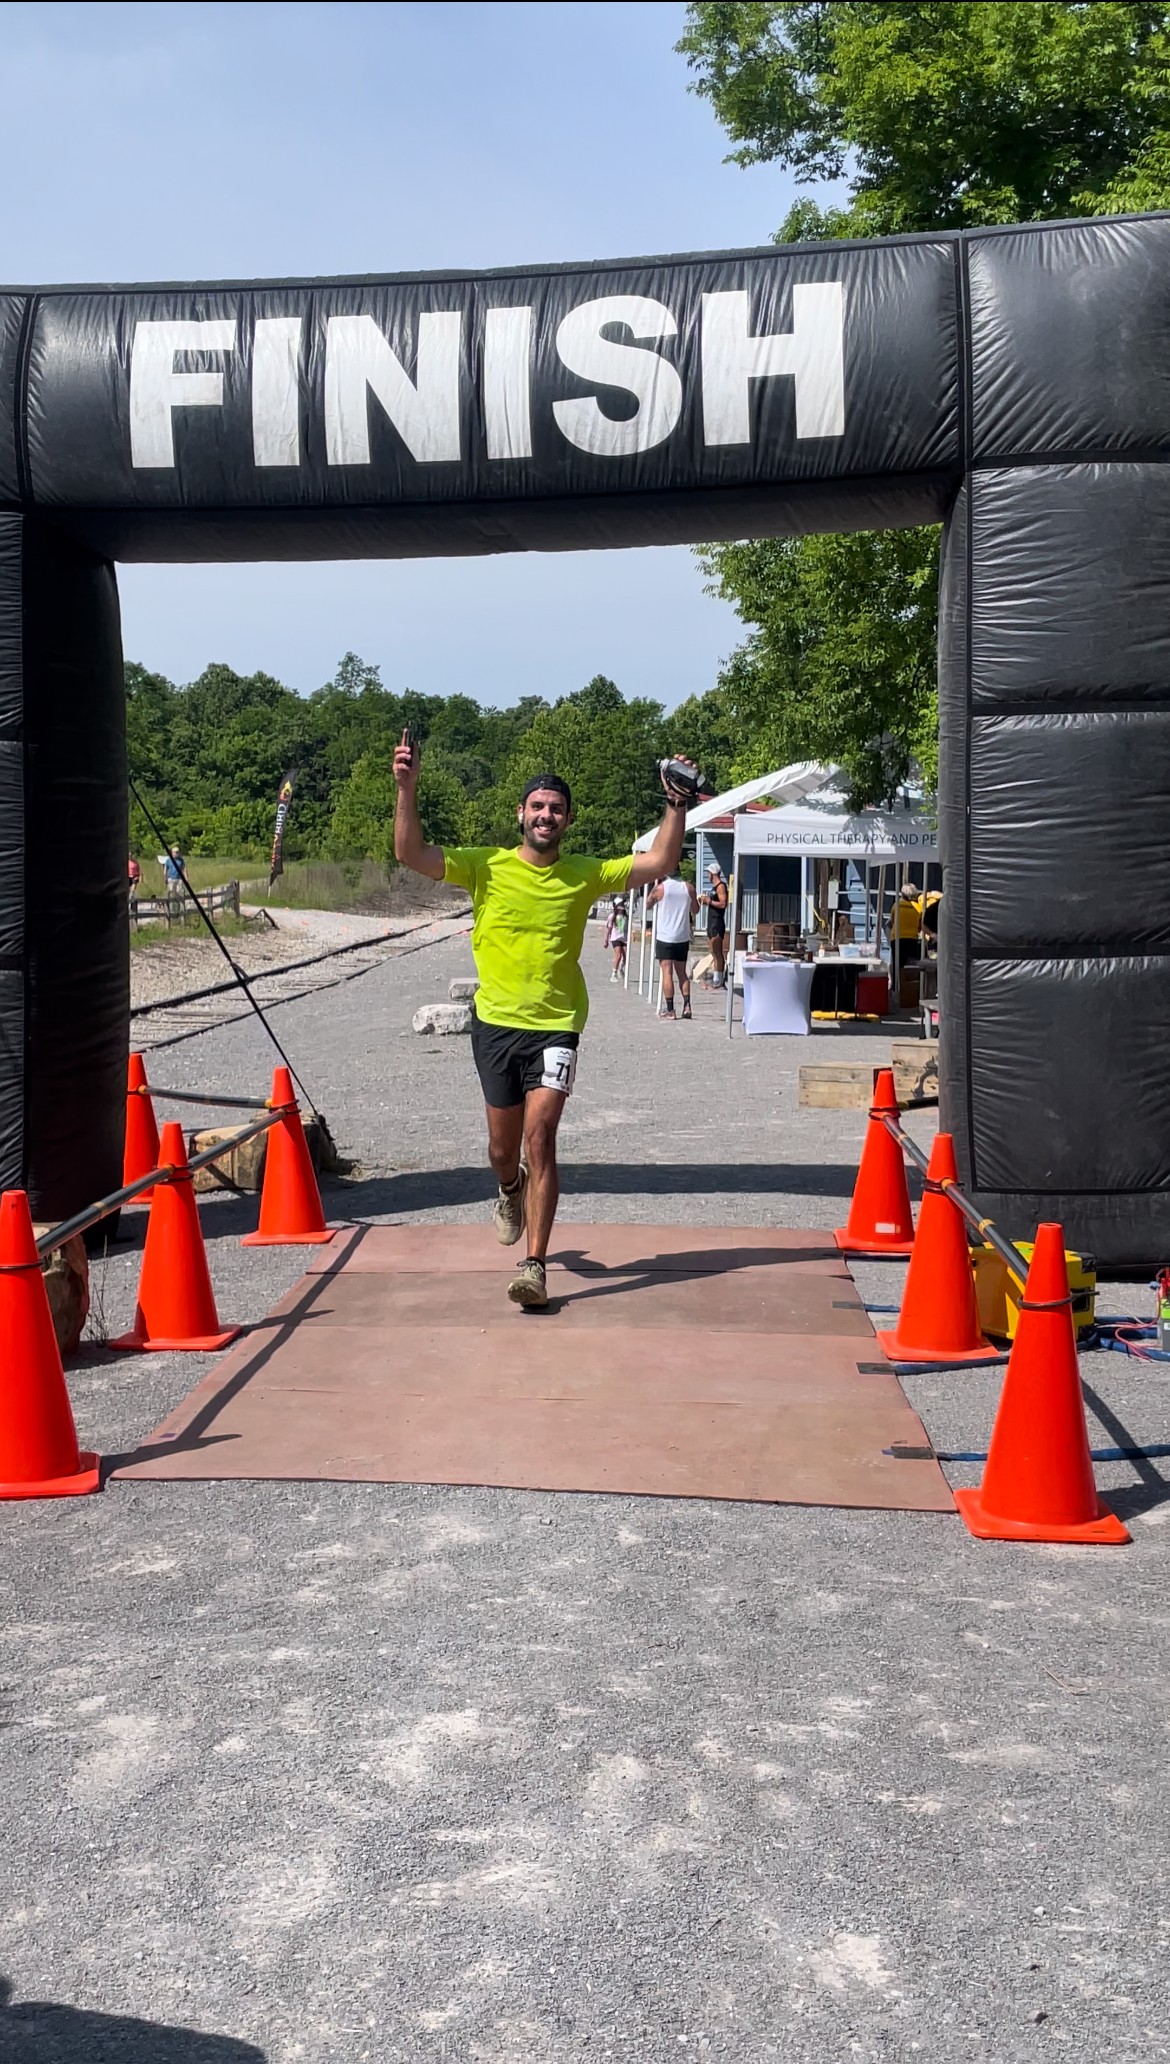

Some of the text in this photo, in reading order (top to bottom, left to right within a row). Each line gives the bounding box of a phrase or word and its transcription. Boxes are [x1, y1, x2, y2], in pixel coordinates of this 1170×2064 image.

[131, 281, 845, 469] FINISH
[766, 833, 827, 845] PHYSICAL
[830, 833, 886, 845] THERAPY
[891, 833, 918, 846] AND
[556, 1062, 571, 1085] 71
